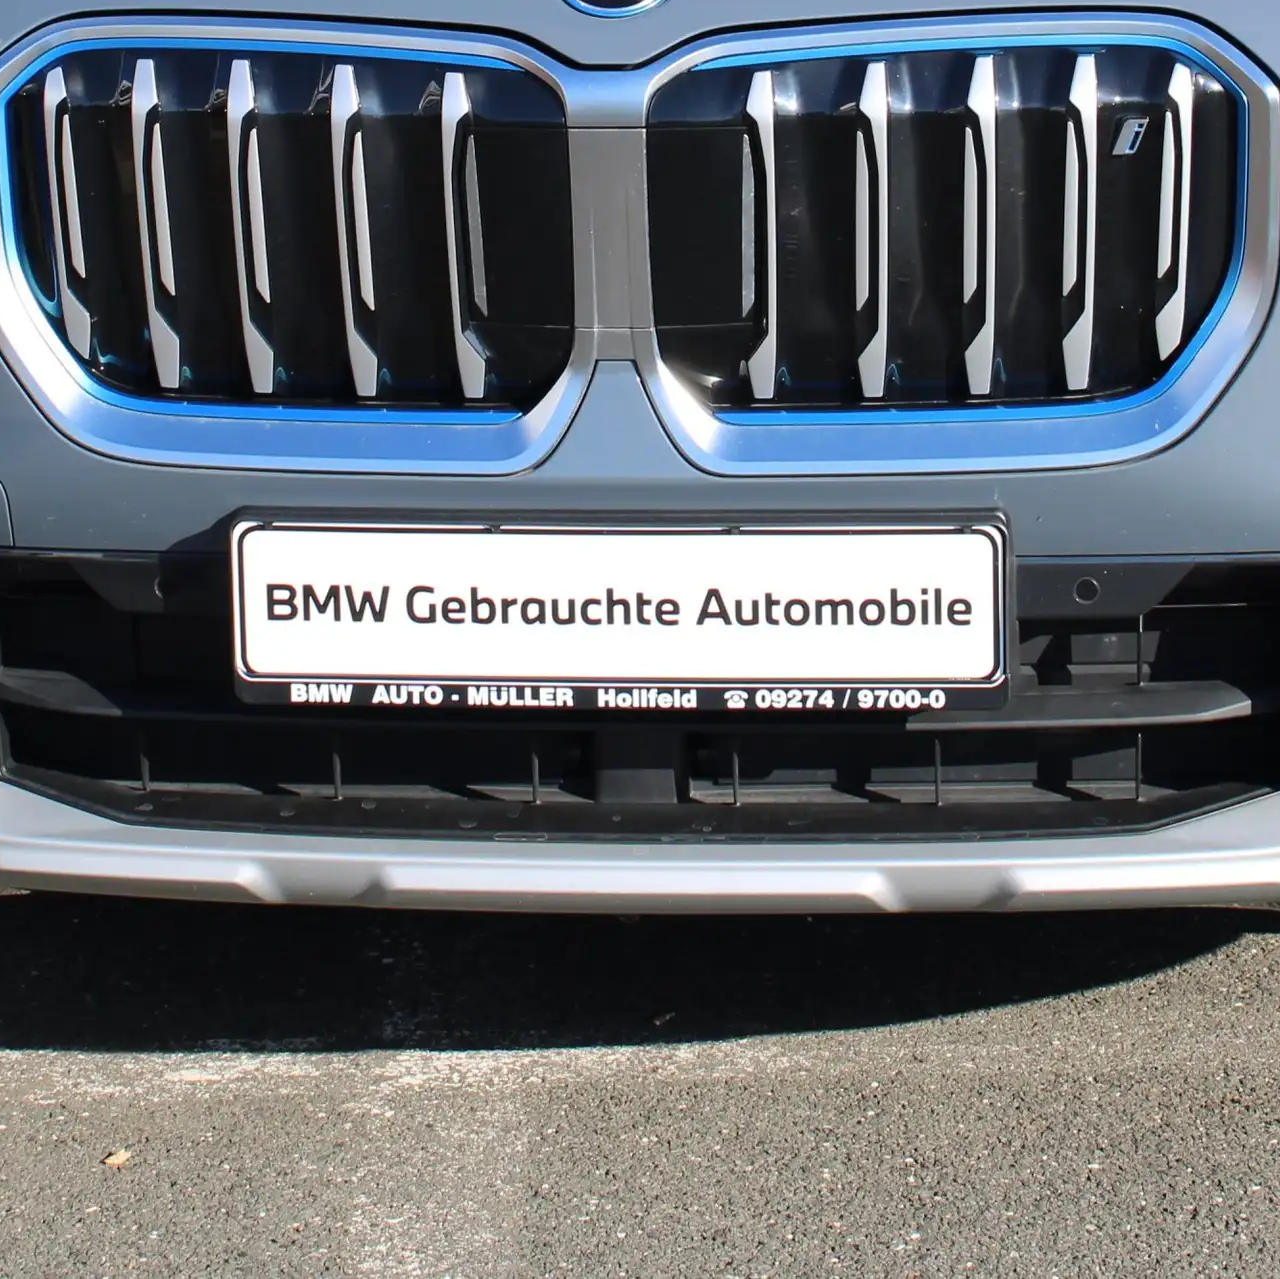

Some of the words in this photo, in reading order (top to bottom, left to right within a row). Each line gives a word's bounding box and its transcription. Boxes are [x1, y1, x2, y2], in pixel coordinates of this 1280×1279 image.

[266, 583, 390, 623] BMW
[406, 585, 680, 626] Gebrauchte
[696, 588, 972, 626] Automobile
[290, 683, 354, 704] BMW
[371, 684, 444, 706] AUTO
[467, 685, 575, 707] MÜLLER
[597, 687, 698, 709] Hollfeld
[754, 688, 835, 709] 09274
[856, 688, 947, 709] 9700-0
